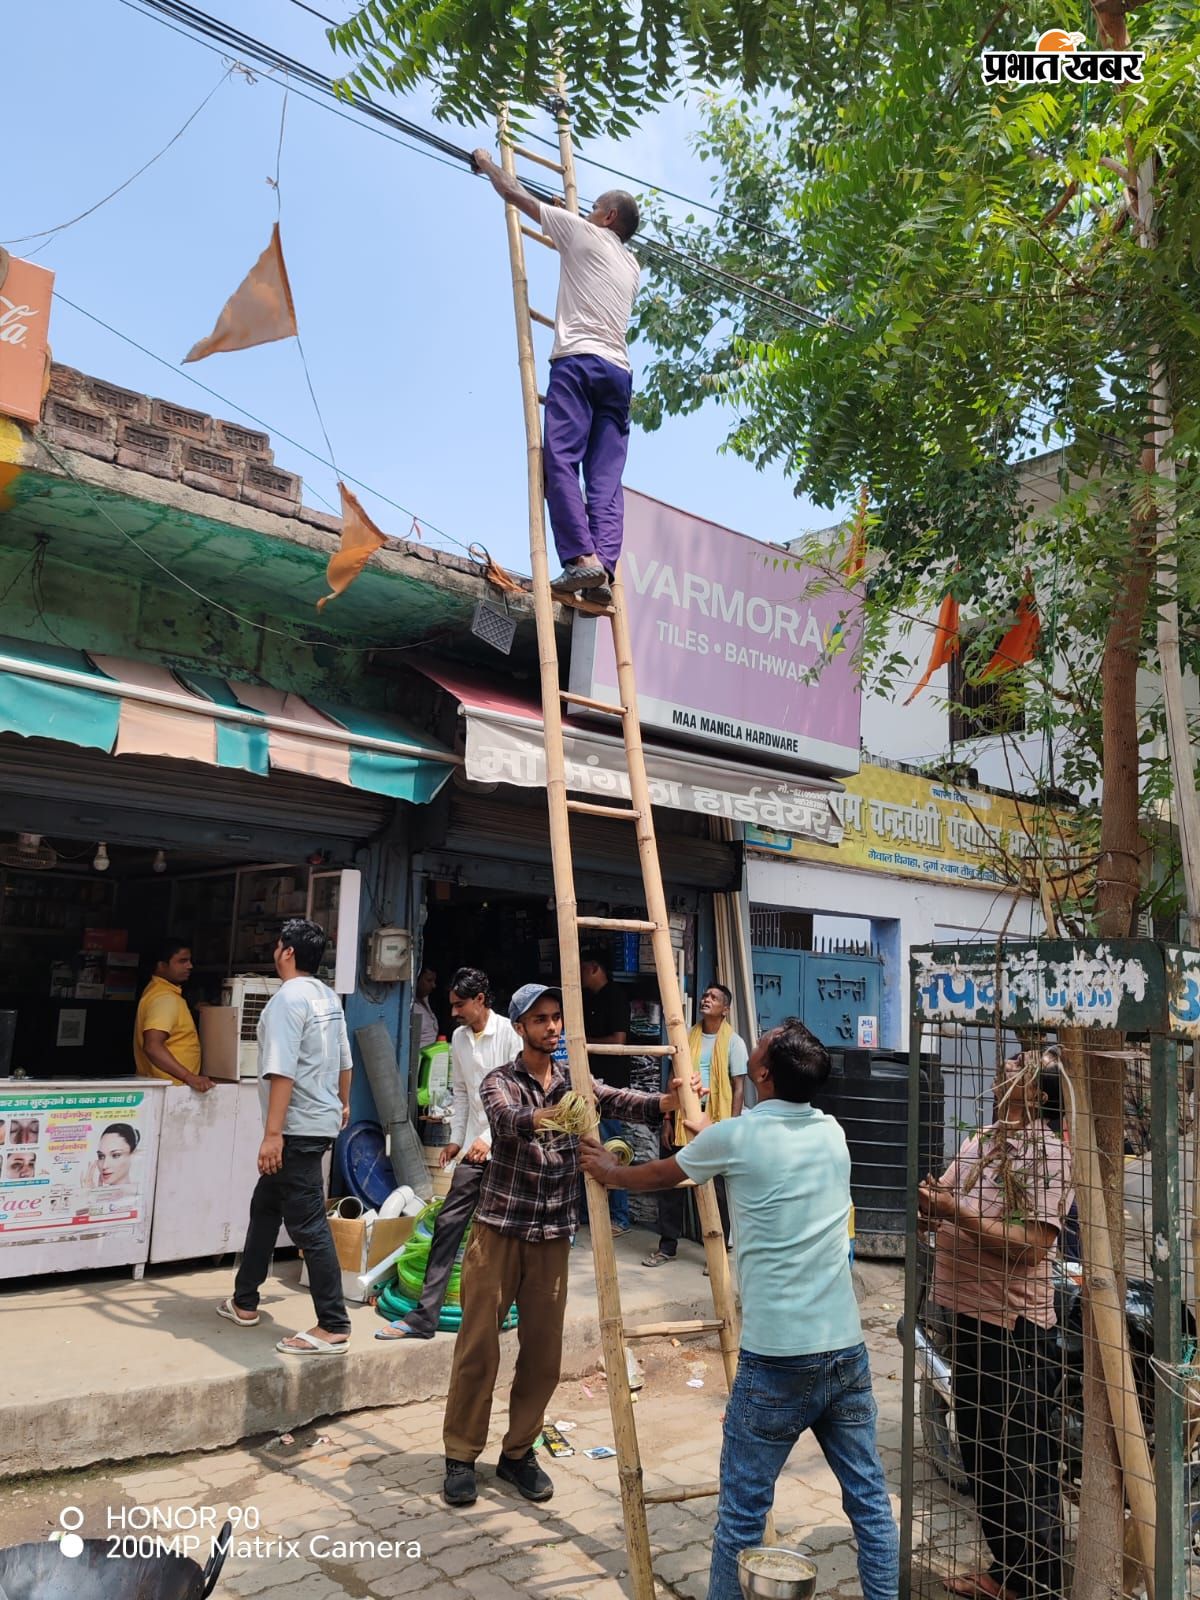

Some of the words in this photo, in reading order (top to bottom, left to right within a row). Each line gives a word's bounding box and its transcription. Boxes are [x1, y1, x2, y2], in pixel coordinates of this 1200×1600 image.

[626, 552, 824, 653] VARMORA
[656, 619, 710, 656] TILES
[672, 709, 697, 729] MAA
[699, 716, 743, 741] MANGLA
[745, 727, 799, 753] HARDWARE
[0, 1195, 42, 1212] ace
